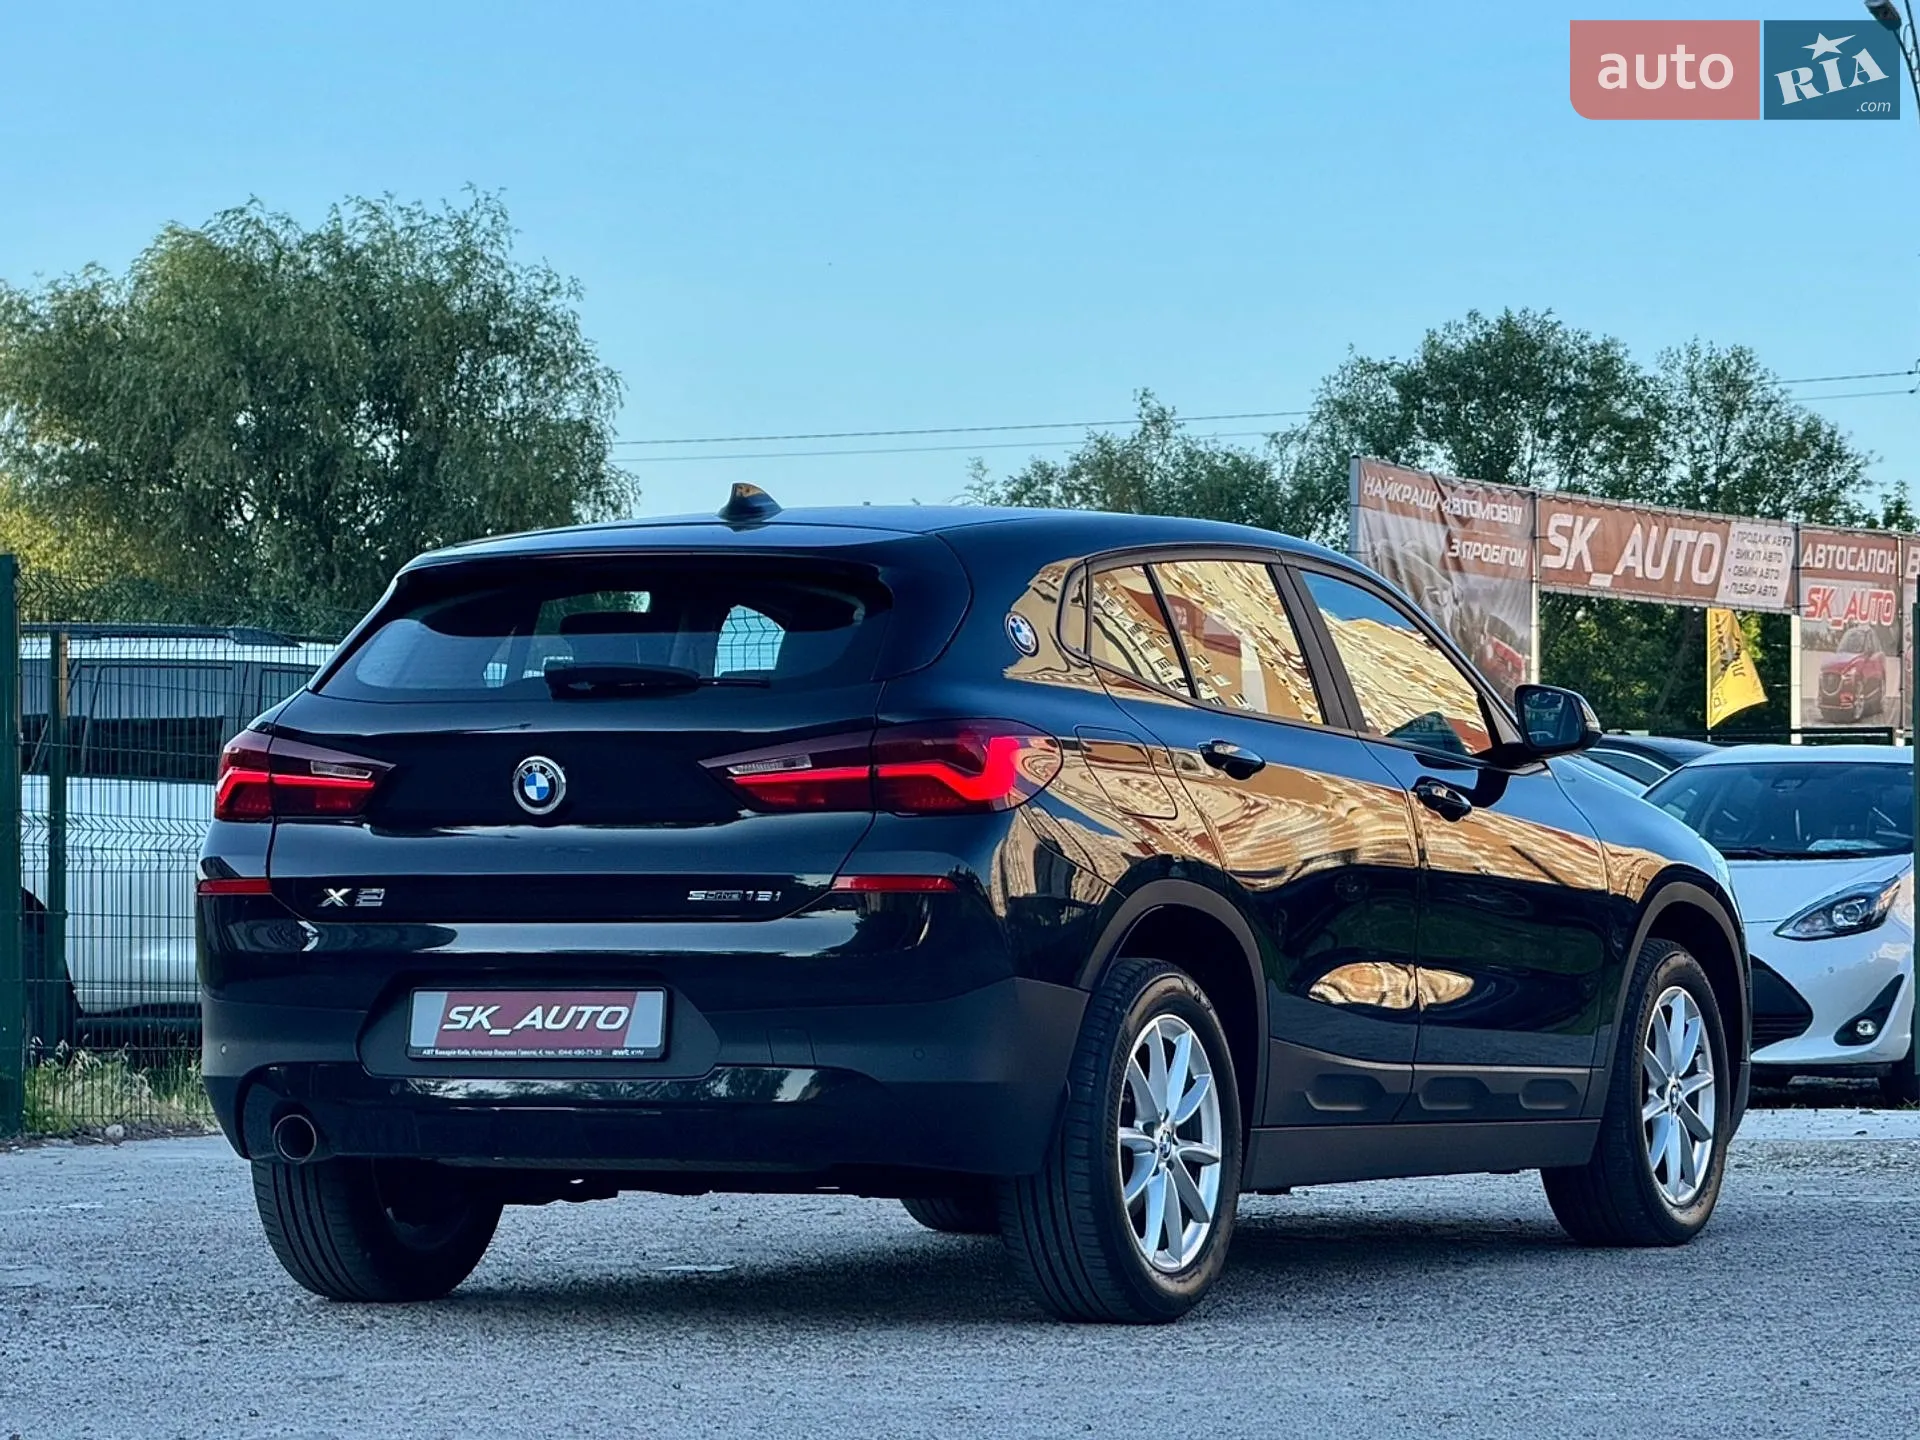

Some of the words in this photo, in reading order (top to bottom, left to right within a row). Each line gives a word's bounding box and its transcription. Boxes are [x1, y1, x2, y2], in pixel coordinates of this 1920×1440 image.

[1540, 512, 1722, 588] SK_AUTO
[1800, 542, 1897, 575] АВТОСАЛОН
[1803, 585, 1896, 630] SK_AUTO
[318, 887, 386, 908] X2
[442, 1005, 630, 1036] SK_AUTO
